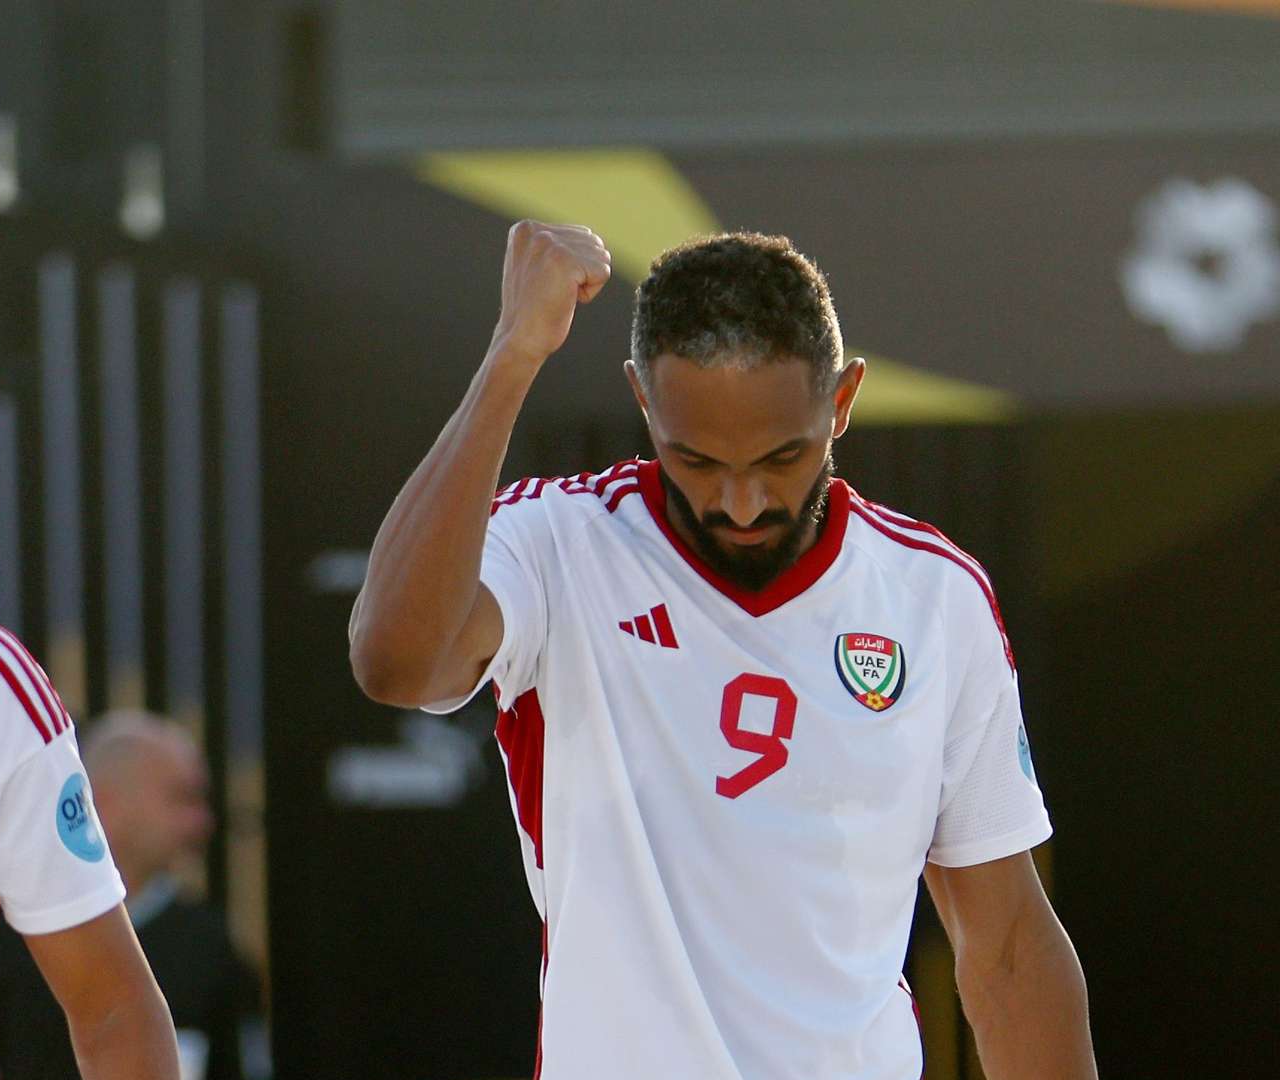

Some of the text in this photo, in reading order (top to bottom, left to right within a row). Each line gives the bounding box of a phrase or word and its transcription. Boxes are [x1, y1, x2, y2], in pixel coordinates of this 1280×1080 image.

[854, 655, 886, 669] UAE
[863, 668, 881, 679] FA
[716, 673, 798, 798] 9
